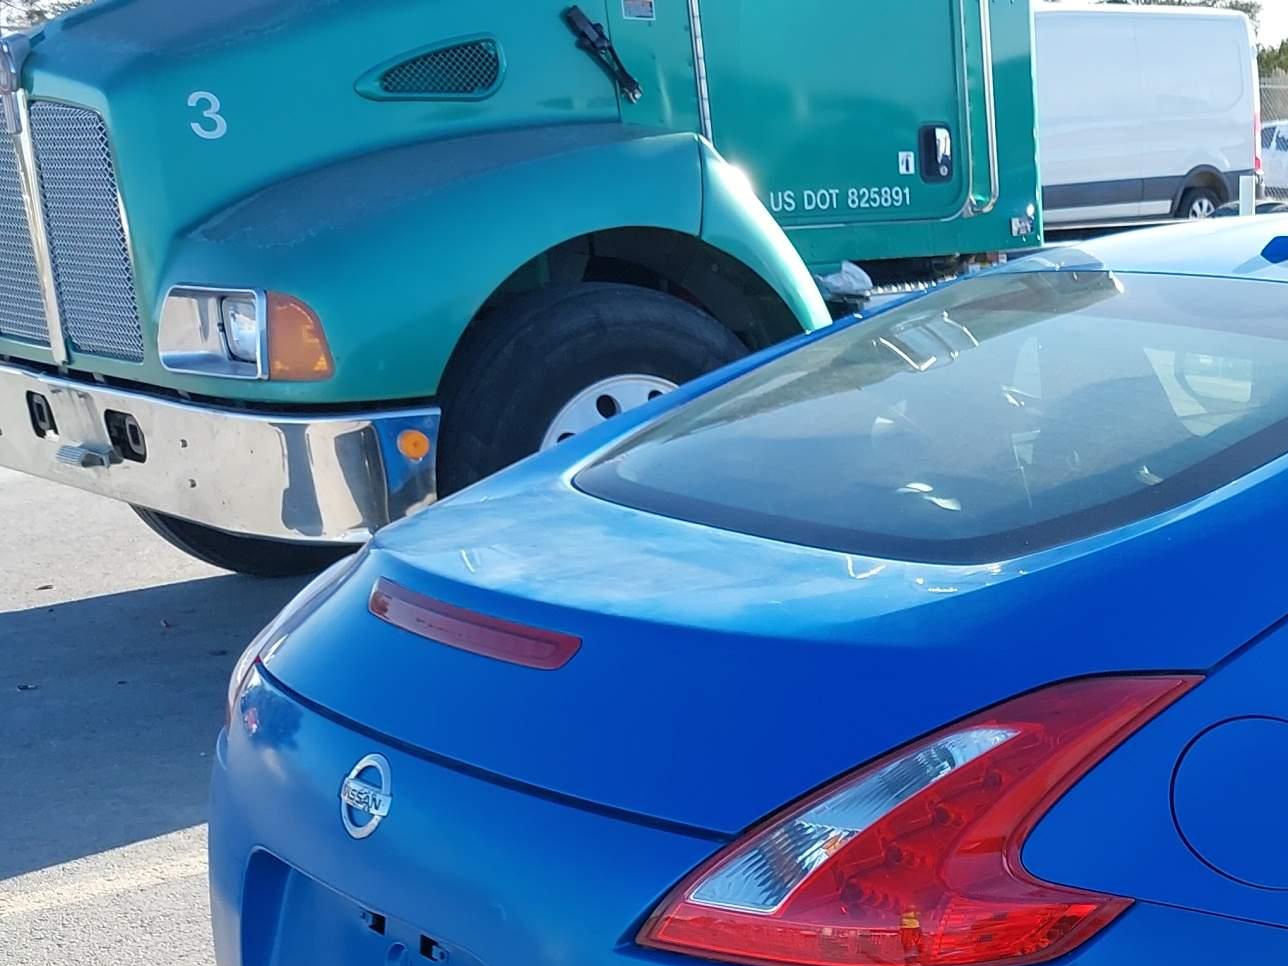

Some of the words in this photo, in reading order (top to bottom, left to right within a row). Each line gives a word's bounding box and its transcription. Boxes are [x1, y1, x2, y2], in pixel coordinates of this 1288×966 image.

[187, 90, 227, 139] 3
[770, 190, 796, 212] US
[803, 189, 840, 210] DOT
[847, 186, 911, 209] 825891
